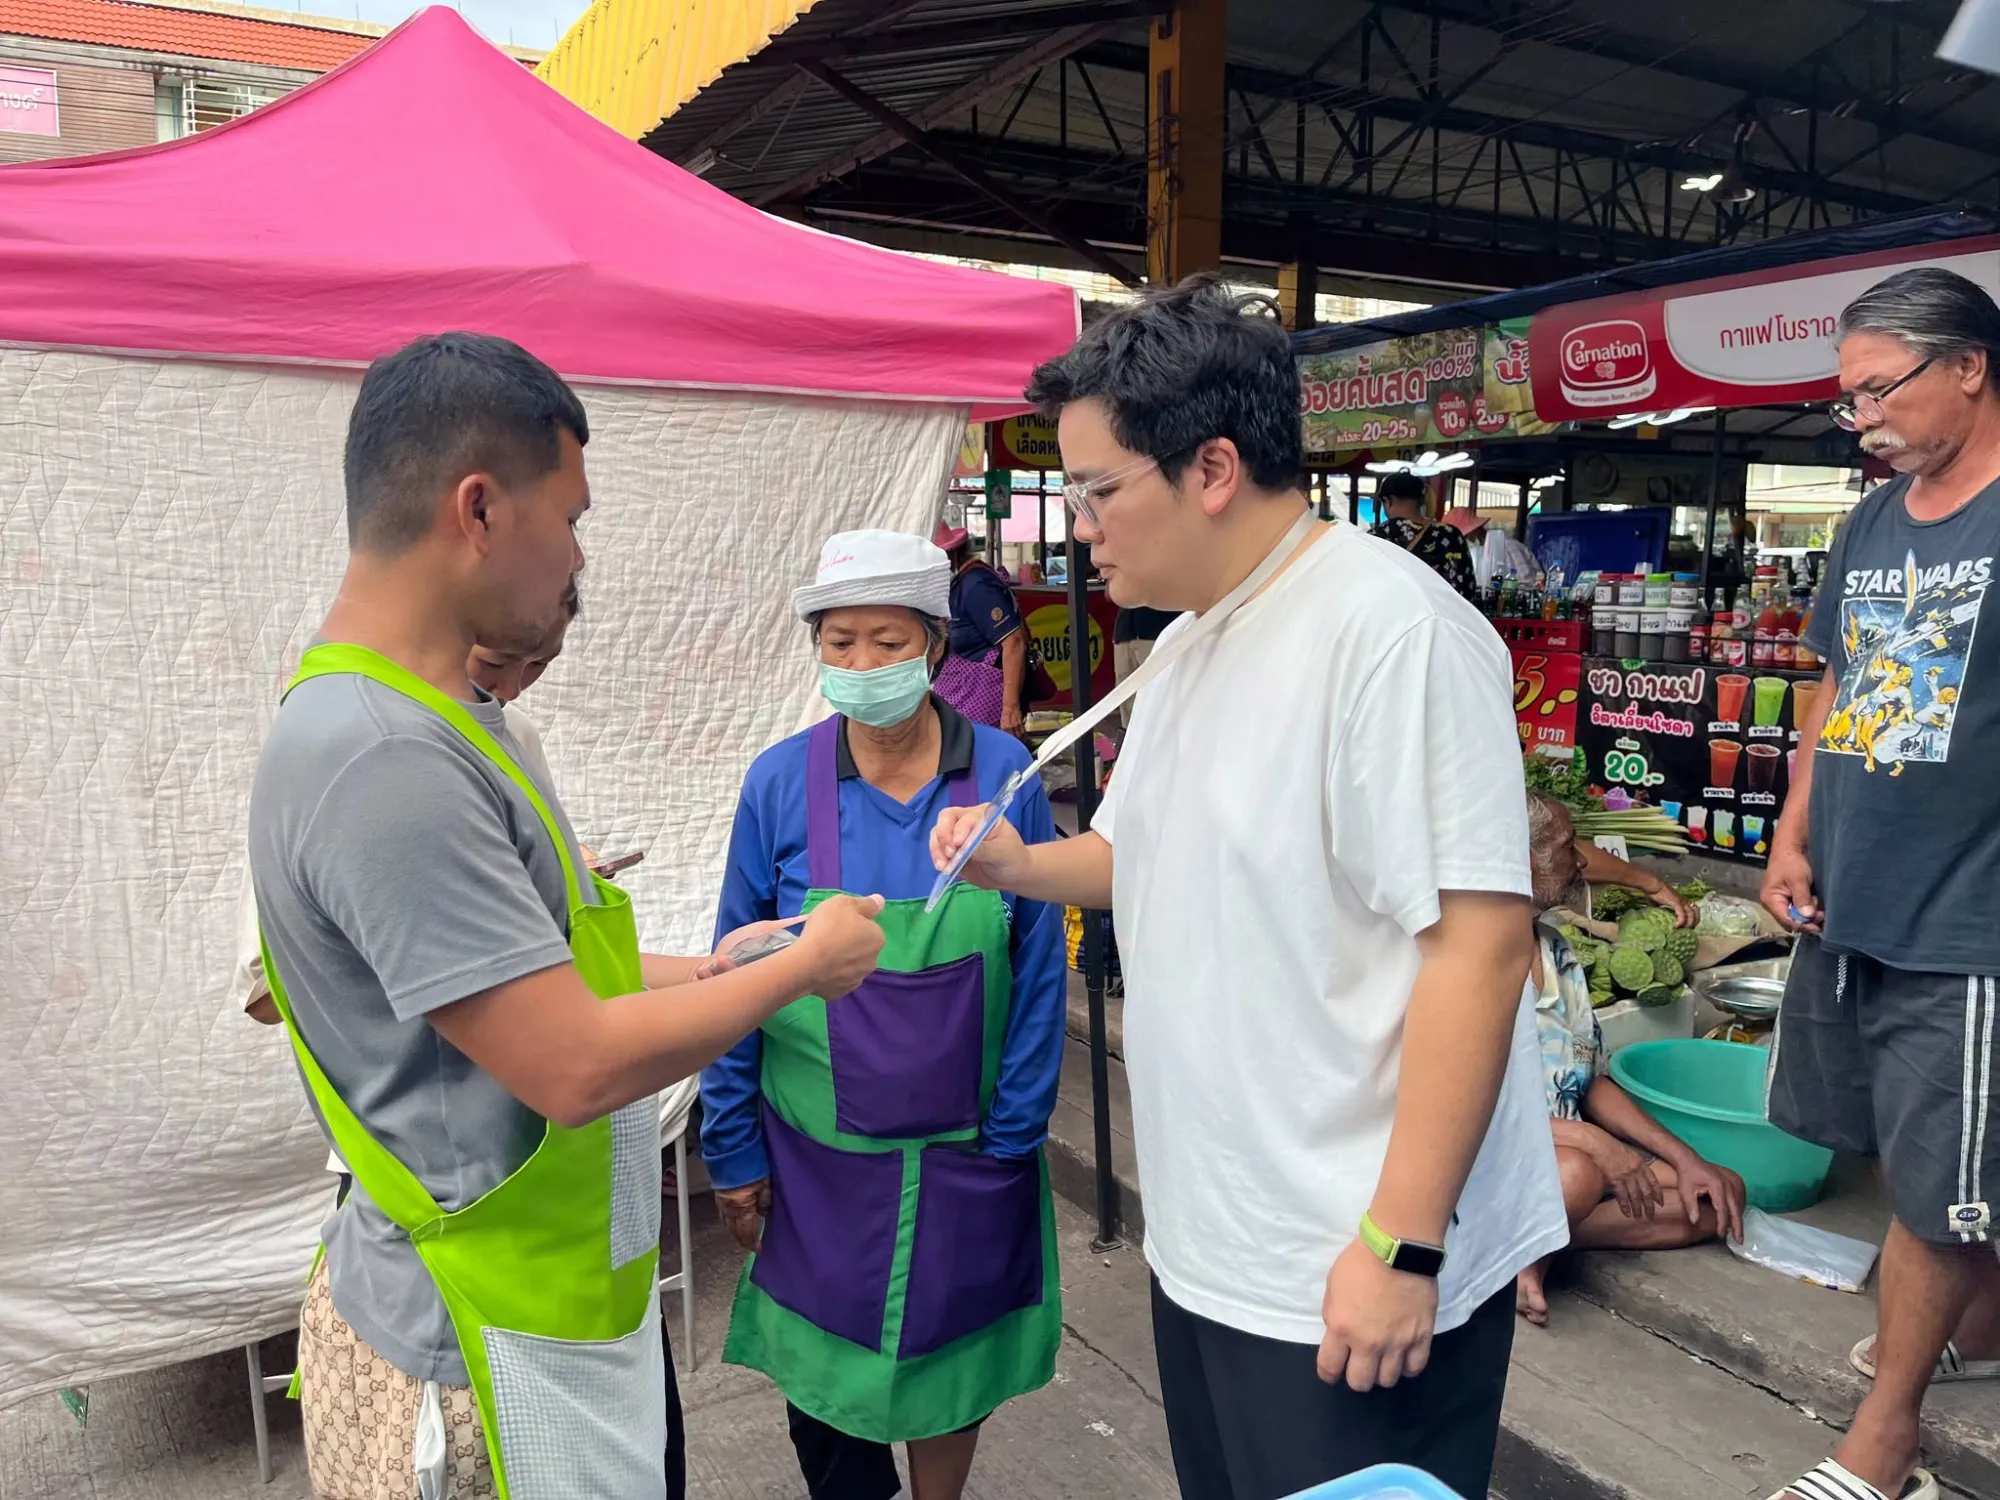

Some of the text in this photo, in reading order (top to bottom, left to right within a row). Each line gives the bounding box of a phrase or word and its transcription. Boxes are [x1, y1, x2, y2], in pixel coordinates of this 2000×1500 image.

[1424, 357, 1475, 382] 100%
[1565, 339, 1643, 371] Carnation
[1844, 556, 1994, 595] STAR WARS
[1588, 667, 1705, 704] ชา กาแฟ
[1537, 724, 1566, 744] บาท
[1604, 751, 1665, 786] 20.-
